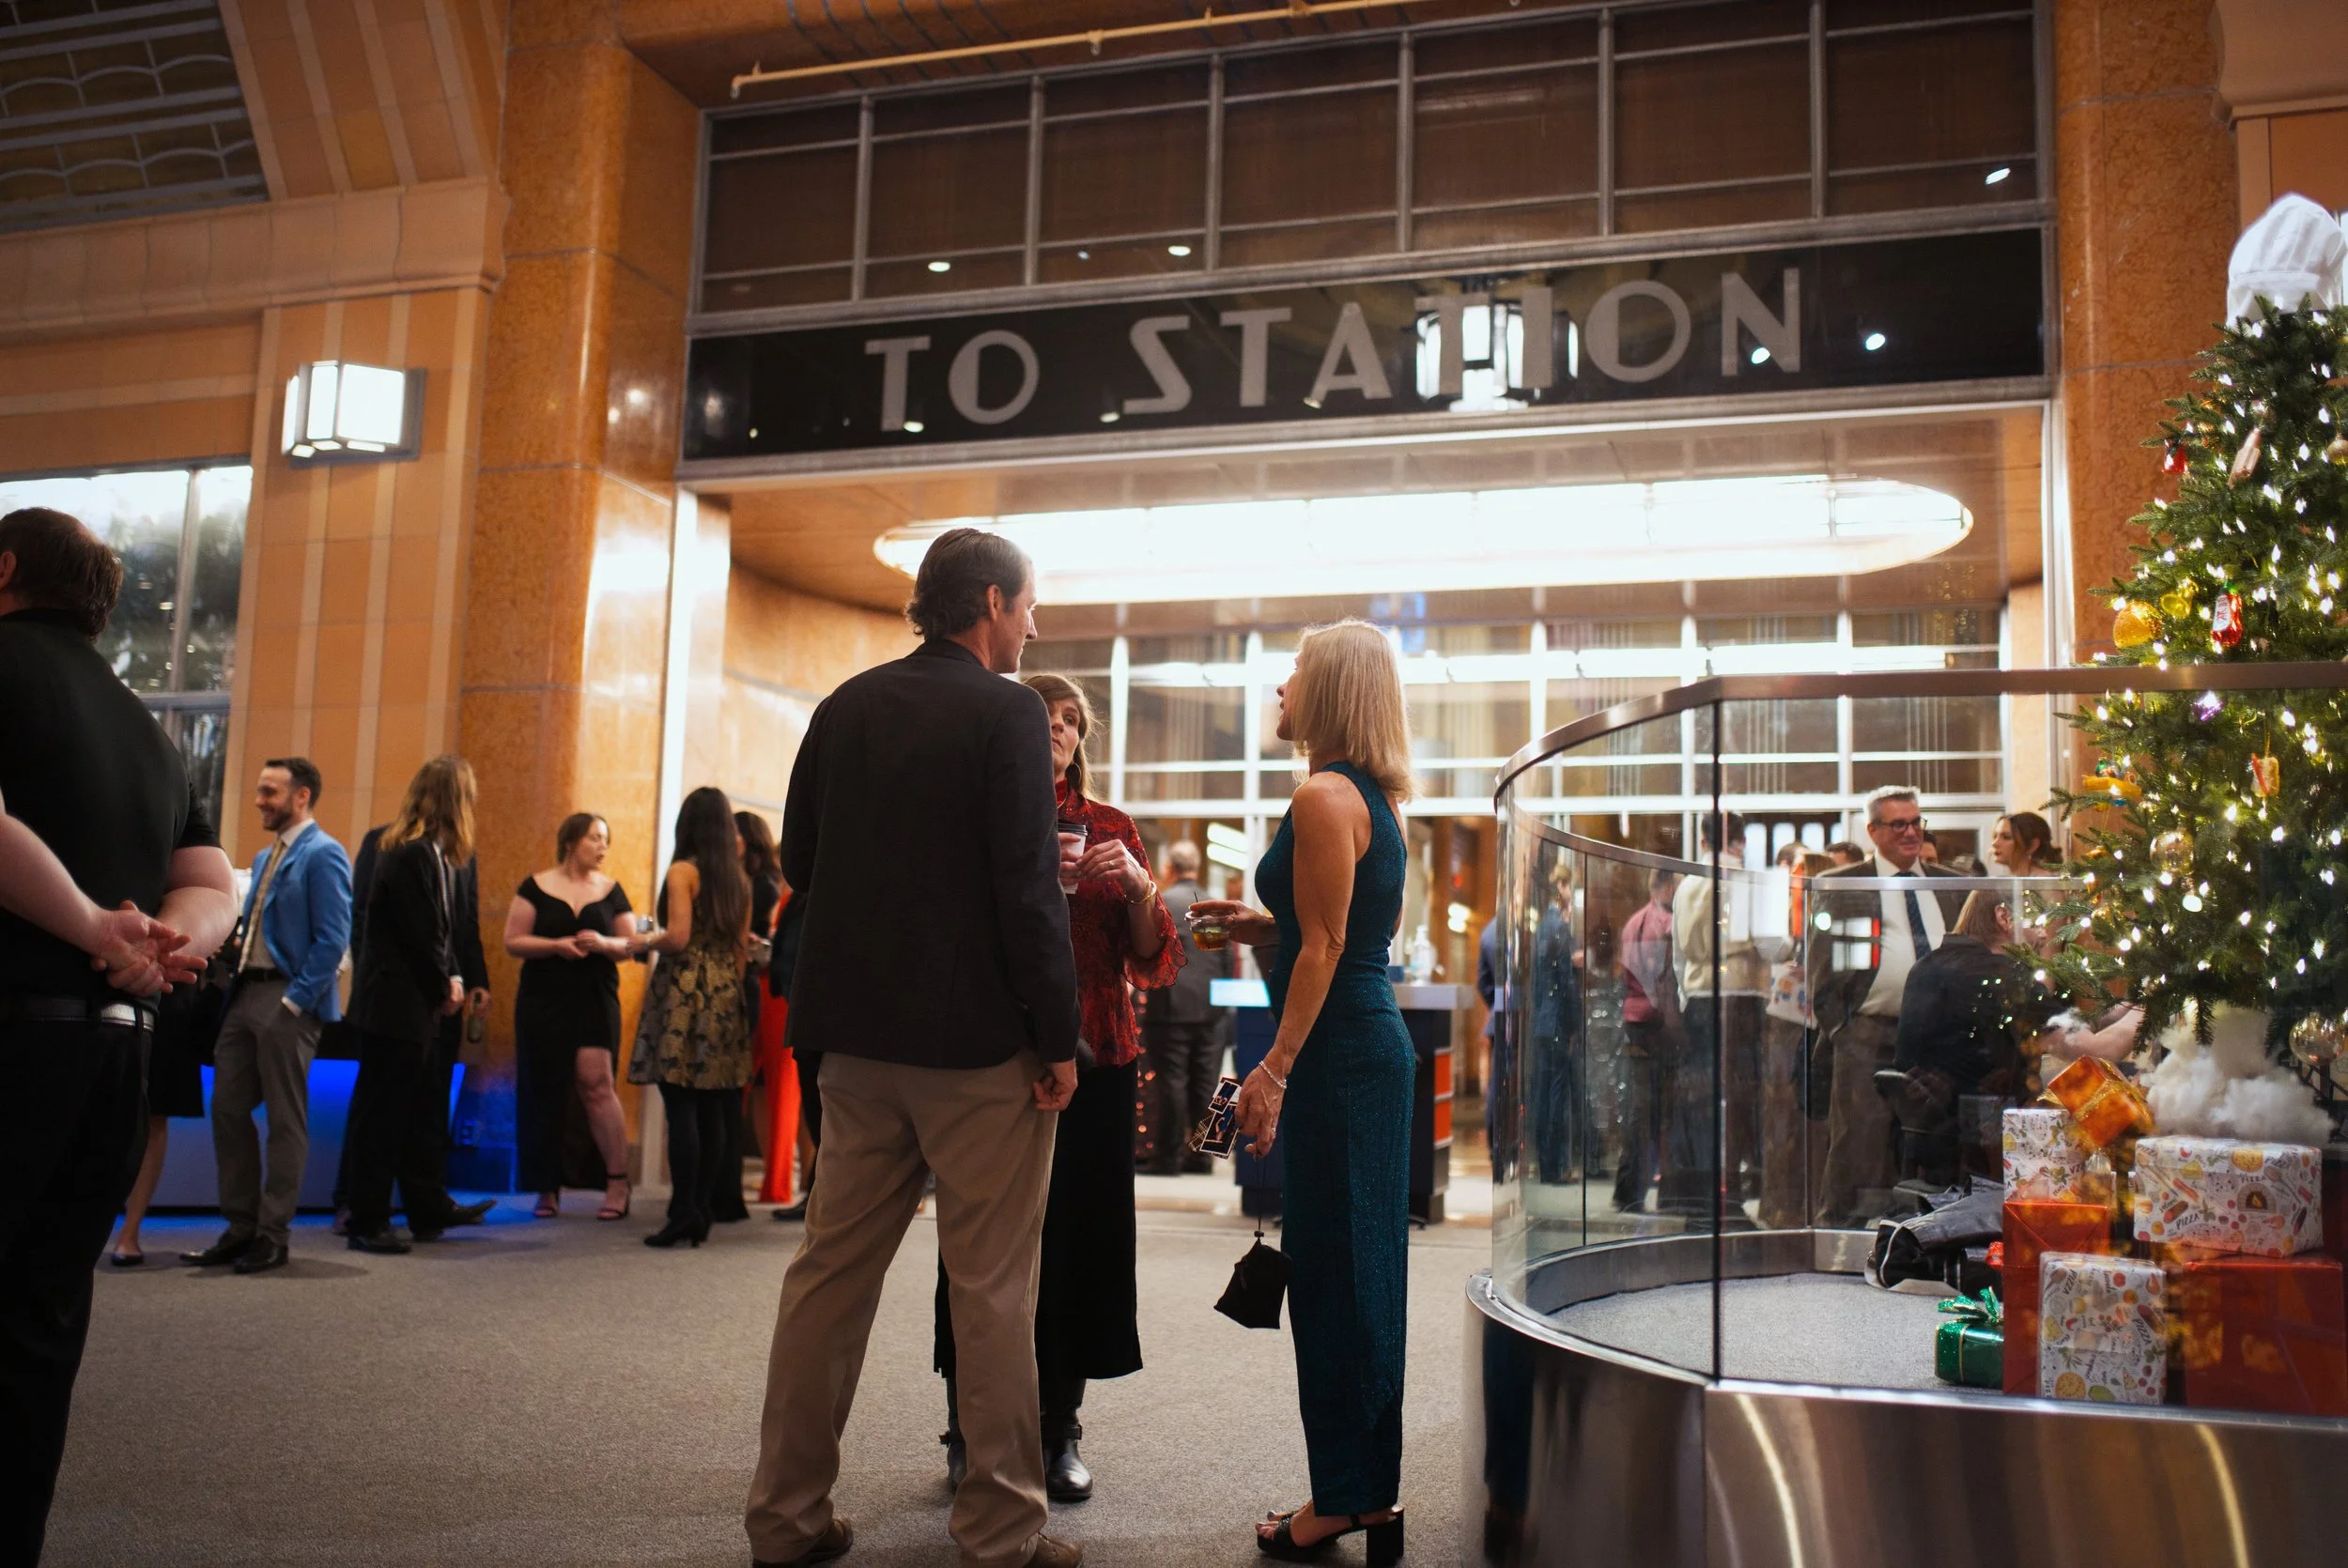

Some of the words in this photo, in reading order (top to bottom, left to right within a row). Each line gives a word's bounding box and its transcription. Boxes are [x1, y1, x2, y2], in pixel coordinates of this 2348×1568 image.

[865, 330, 1039, 432] TO
[1122, 267, 1801, 414] STATION
[2175, 1212, 2200, 1229] PIZZA
[2062, 1268, 2078, 1295] PIZZA
[2133, 1317, 2152, 1345] PIZZA
